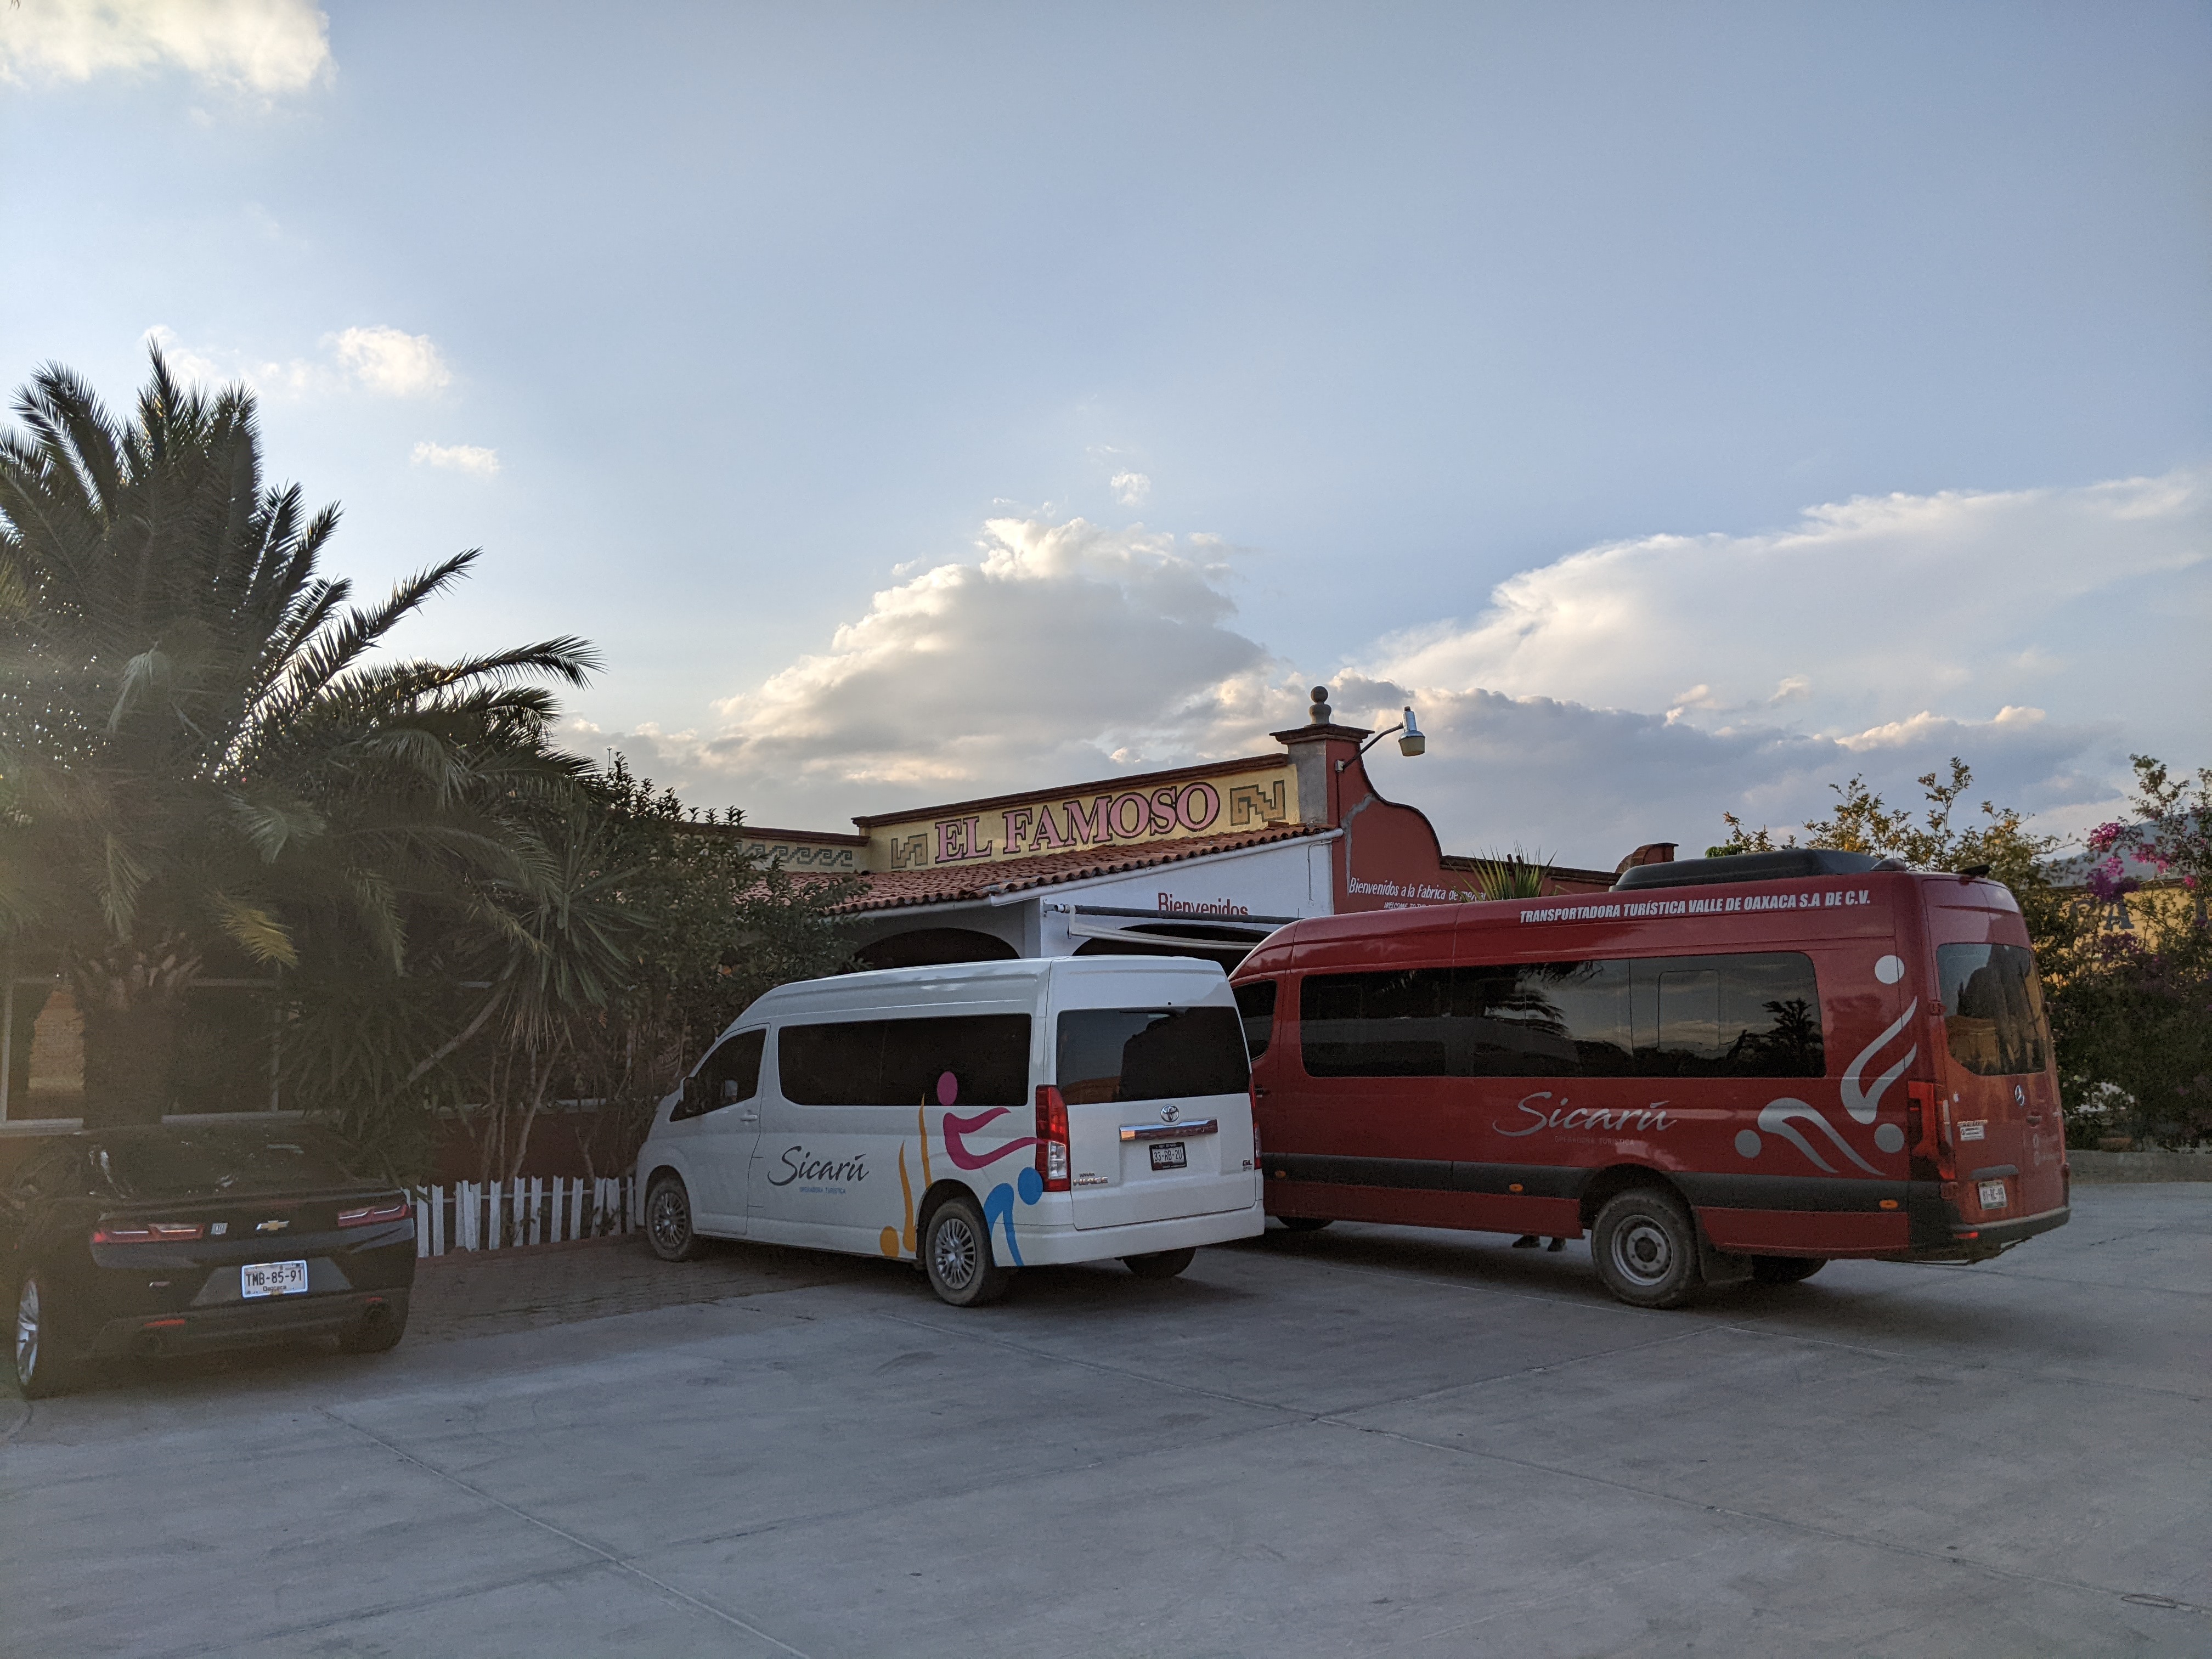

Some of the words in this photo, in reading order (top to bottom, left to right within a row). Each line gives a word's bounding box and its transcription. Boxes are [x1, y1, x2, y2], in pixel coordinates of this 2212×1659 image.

[935, 816, 992, 864] EL
[1003, 782, 1220, 854] FAMOSO
[1349, 877, 1400, 896] Bienvenidos
[1401, 886, 1407, 897] a
[1407, 883, 1415, 898] la
[1158, 892, 1249, 916] Bienvenidos
[1520, 904, 1621, 923] TRANSPORTADORA
[1623, 900, 1685, 917] TURÍSTICA
[1689, 898, 1724, 913] VALLE
[1725, 897, 1742, 911] DE
[1743, 894, 1797, 911] OAXACA
[1825, 891, 1843, 906] DE
[1845, 890, 1871, 905] C.V.
[1492, 1091, 1677, 1137] Sicarú
[767, 1146, 869, 1186] Sicarú
[1154, 1149, 1182, 1161] 33-RB-2U
[246, 1269, 302, 1286] TMB-85-91
